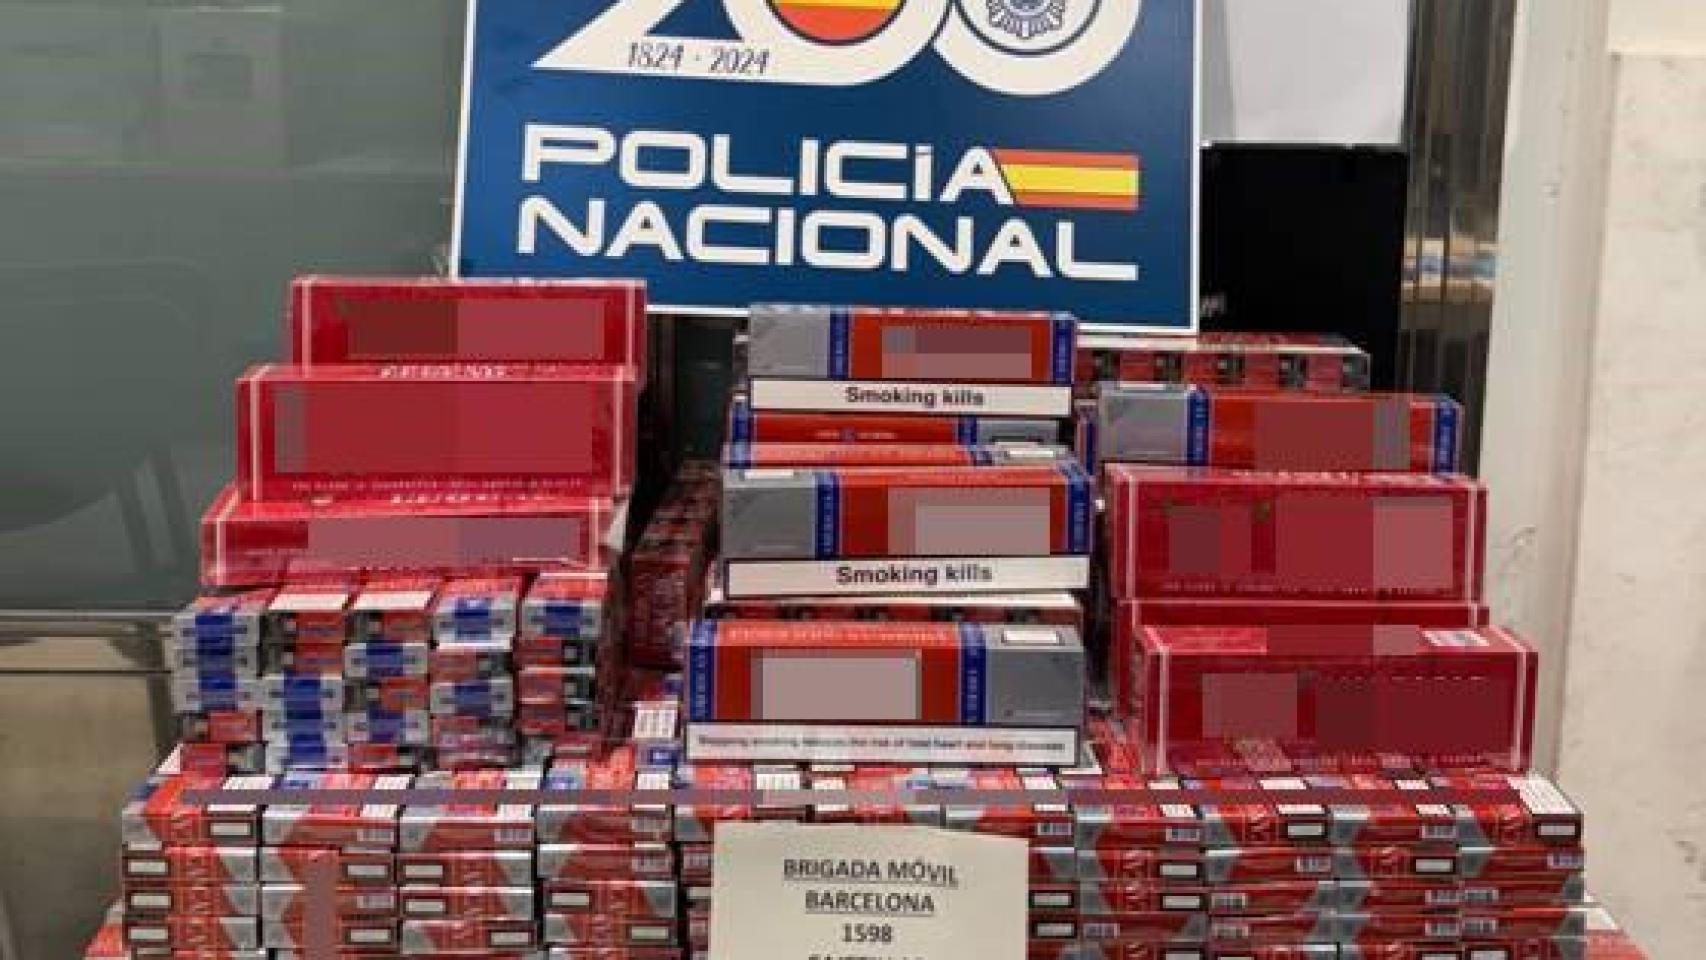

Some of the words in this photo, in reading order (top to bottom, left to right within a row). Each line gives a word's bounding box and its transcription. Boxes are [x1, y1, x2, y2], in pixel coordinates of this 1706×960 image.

[628, 42, 684, 69] 1824
[709, 48, 770, 74] 2024
[517, 196, 1139, 281] NACIONAL
[845, 386, 936, 406] Smoking
[942, 387, 984, 406] kills
[836, 565, 938, 585] Smoking
[945, 564, 993, 582] kills
[783, 858, 881, 879] BRIGADA
[887, 856, 959, 885] MÓVIL
[805, 890, 935, 912] BARCELONA
[841, 923, 892, 943] 1598
